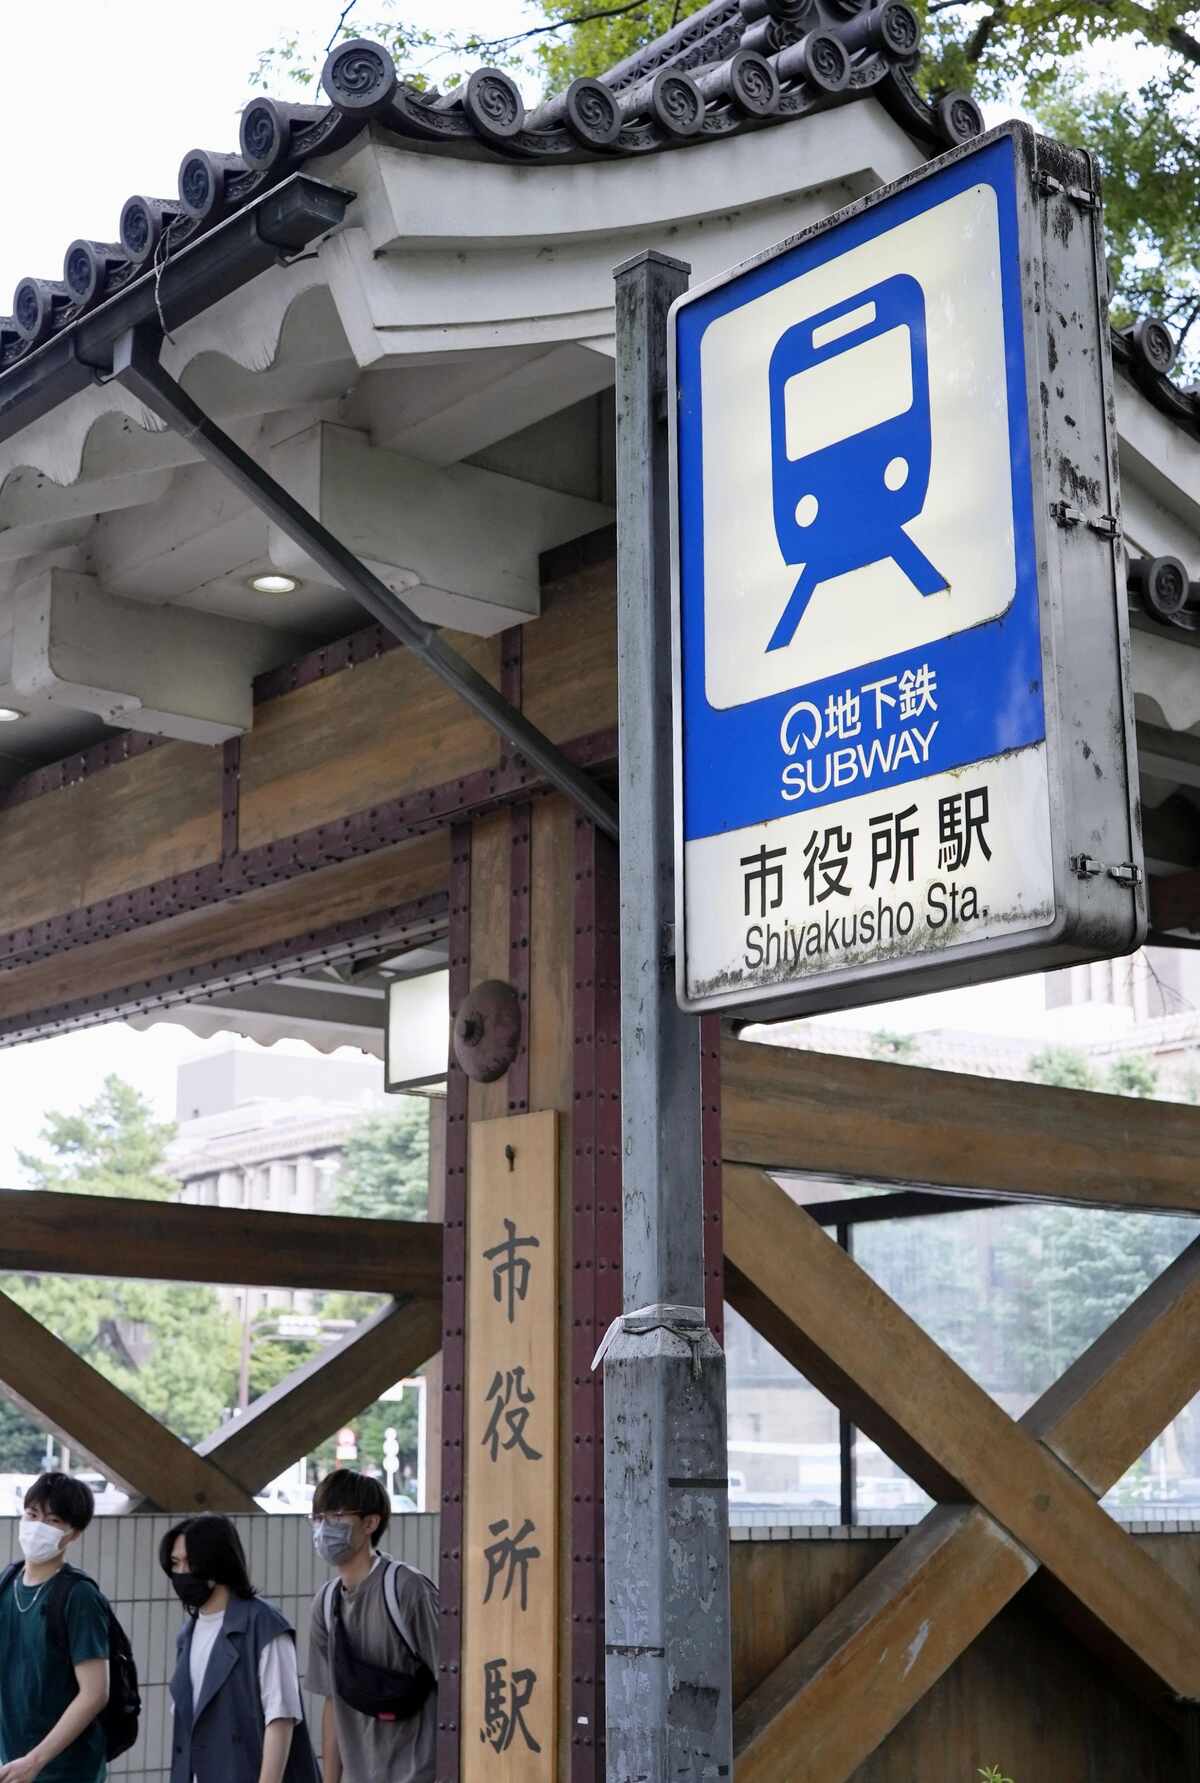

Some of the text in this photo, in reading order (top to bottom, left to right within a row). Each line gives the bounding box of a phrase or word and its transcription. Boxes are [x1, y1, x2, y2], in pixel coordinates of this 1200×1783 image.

[824, 663, 938, 740] 地下鉄
[780, 721, 939, 801] SUBWAY
[740, 786, 992, 918] 市役所駅
[744, 882, 989, 970] Shiyakusho Sta.
[480, 1218, 542, 1754] 市役所駅
